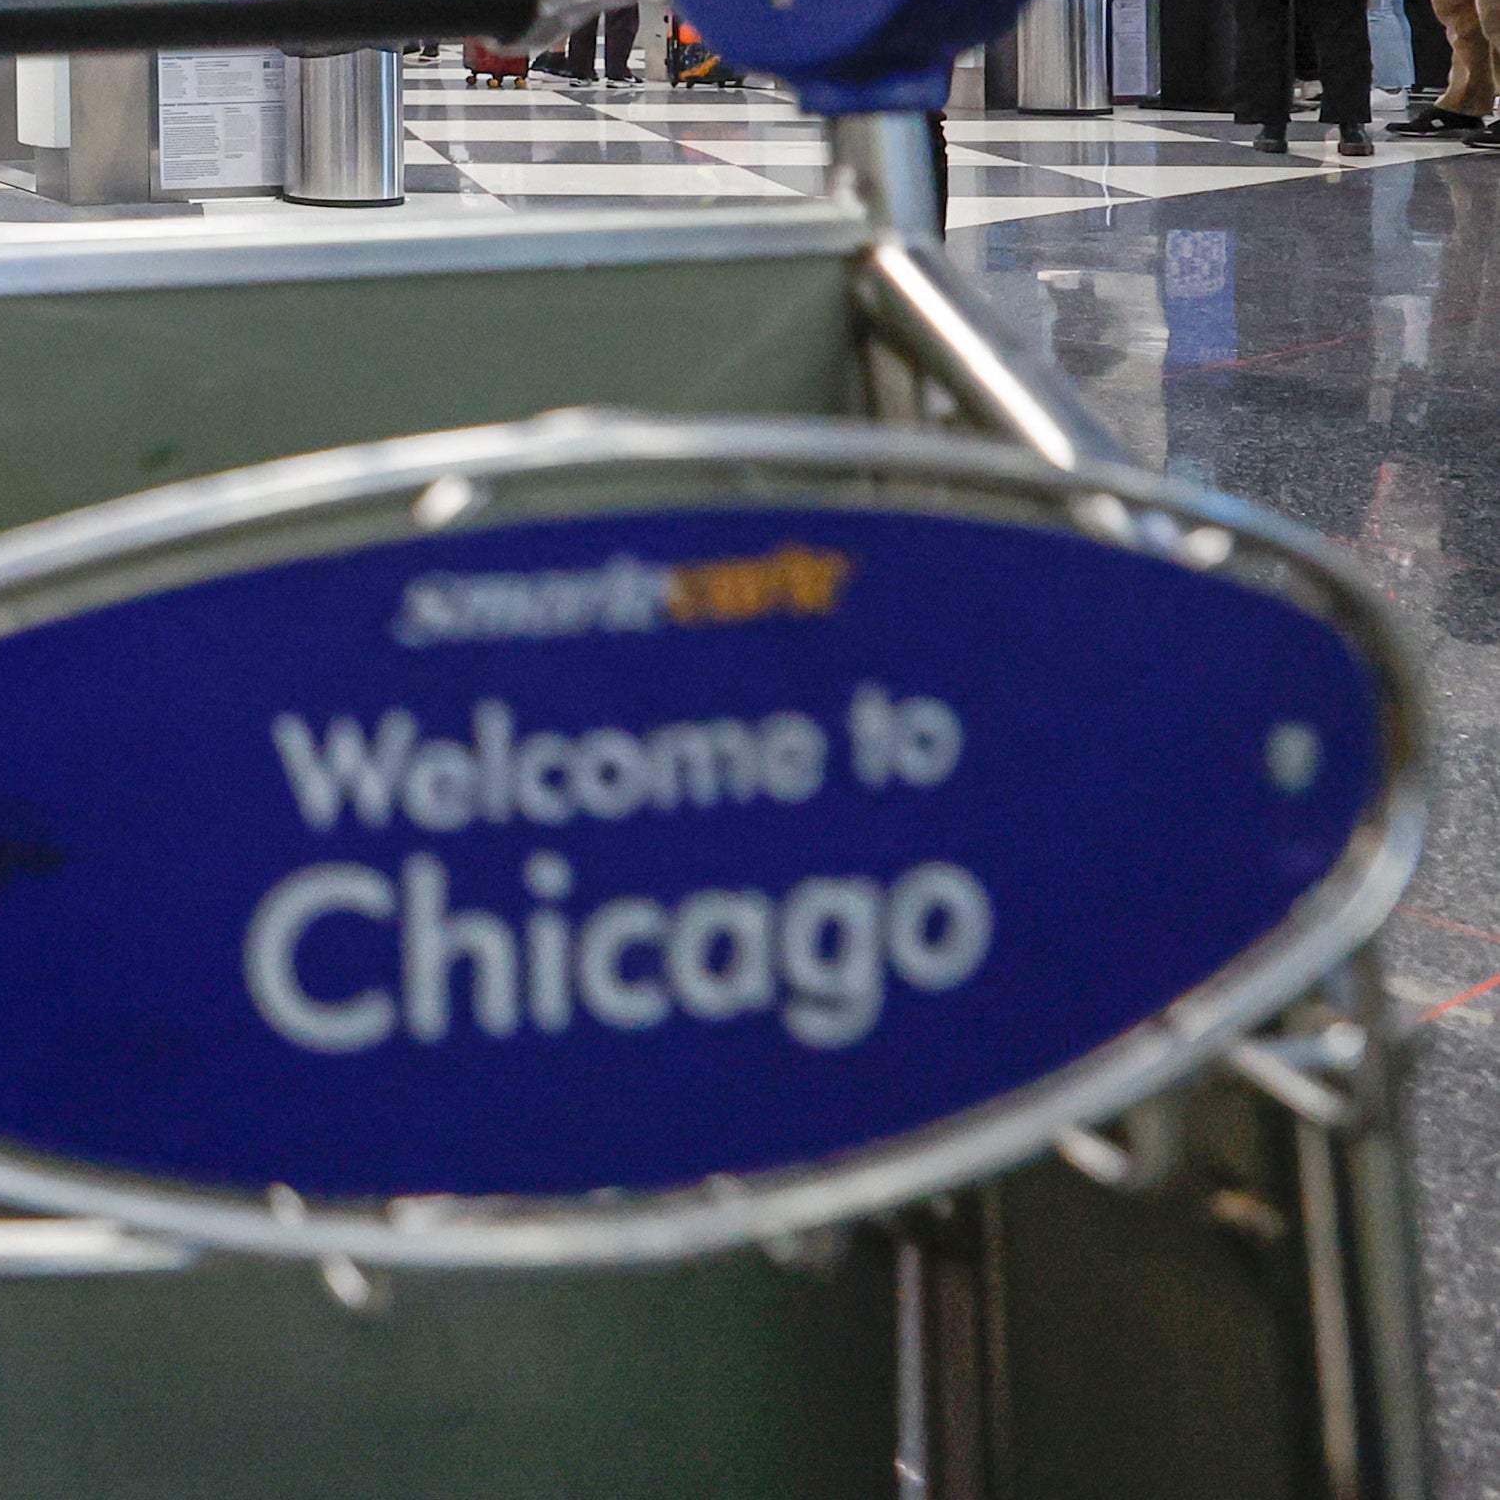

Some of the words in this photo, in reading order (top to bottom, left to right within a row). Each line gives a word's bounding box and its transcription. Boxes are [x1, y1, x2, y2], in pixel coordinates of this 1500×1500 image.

[269, 697, 827, 833] Welcome
[847, 681, 963, 790] to
[243, 848, 994, 1055] Chicago
